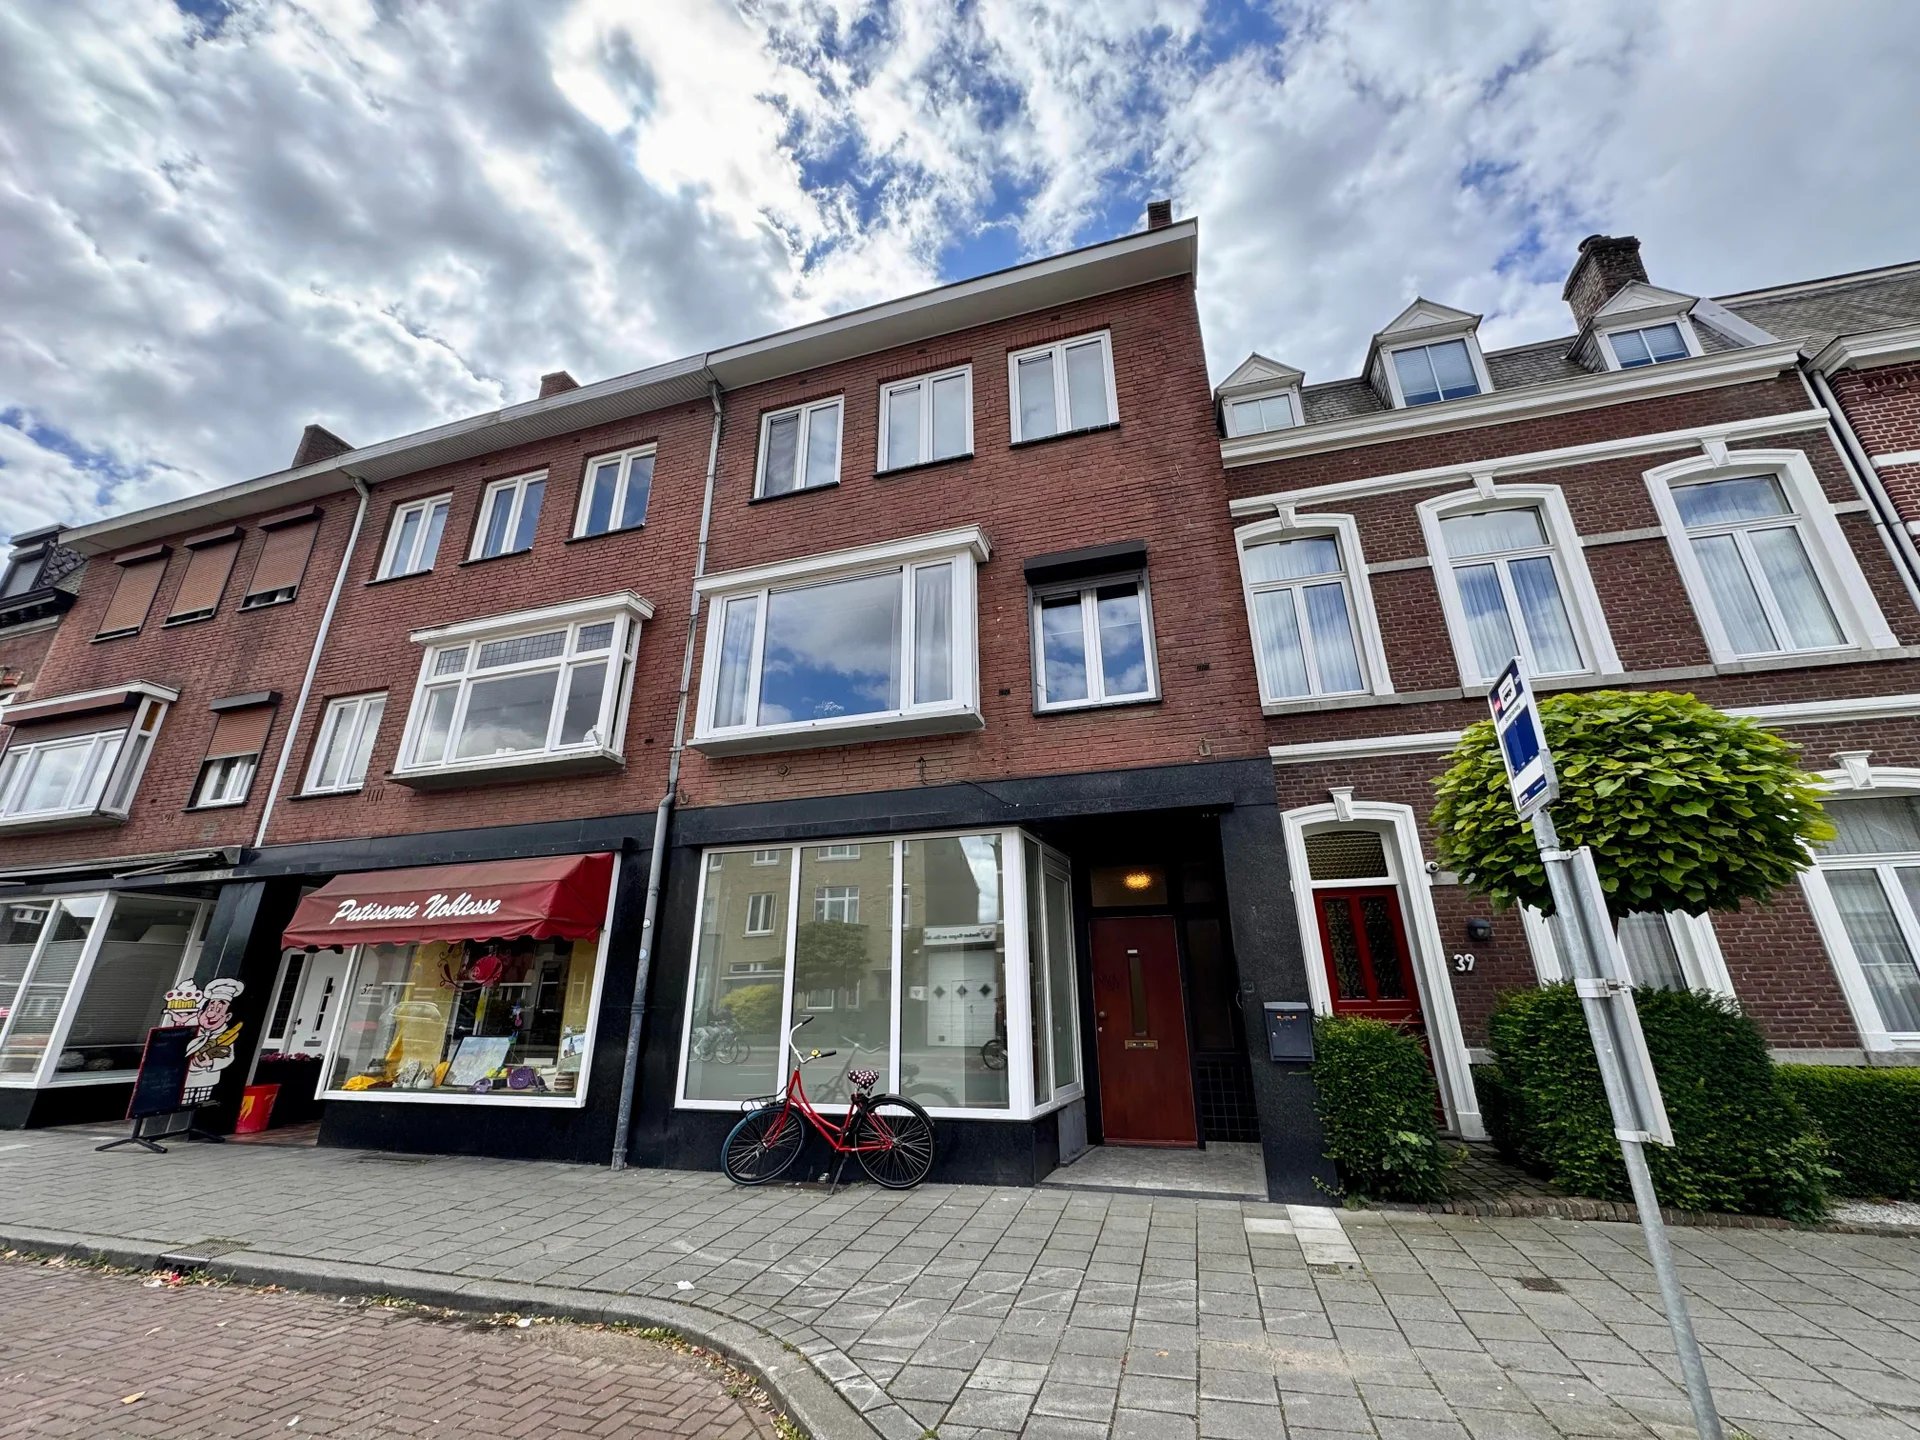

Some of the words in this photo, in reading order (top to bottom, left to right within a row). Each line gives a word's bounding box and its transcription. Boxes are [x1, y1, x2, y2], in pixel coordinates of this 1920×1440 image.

[329, 899, 420, 924] Patisserie
[422, 892, 501, 920] Noblesse
[1453, 953, 1475, 971] 39
[360, 983, 374, 995] 37
